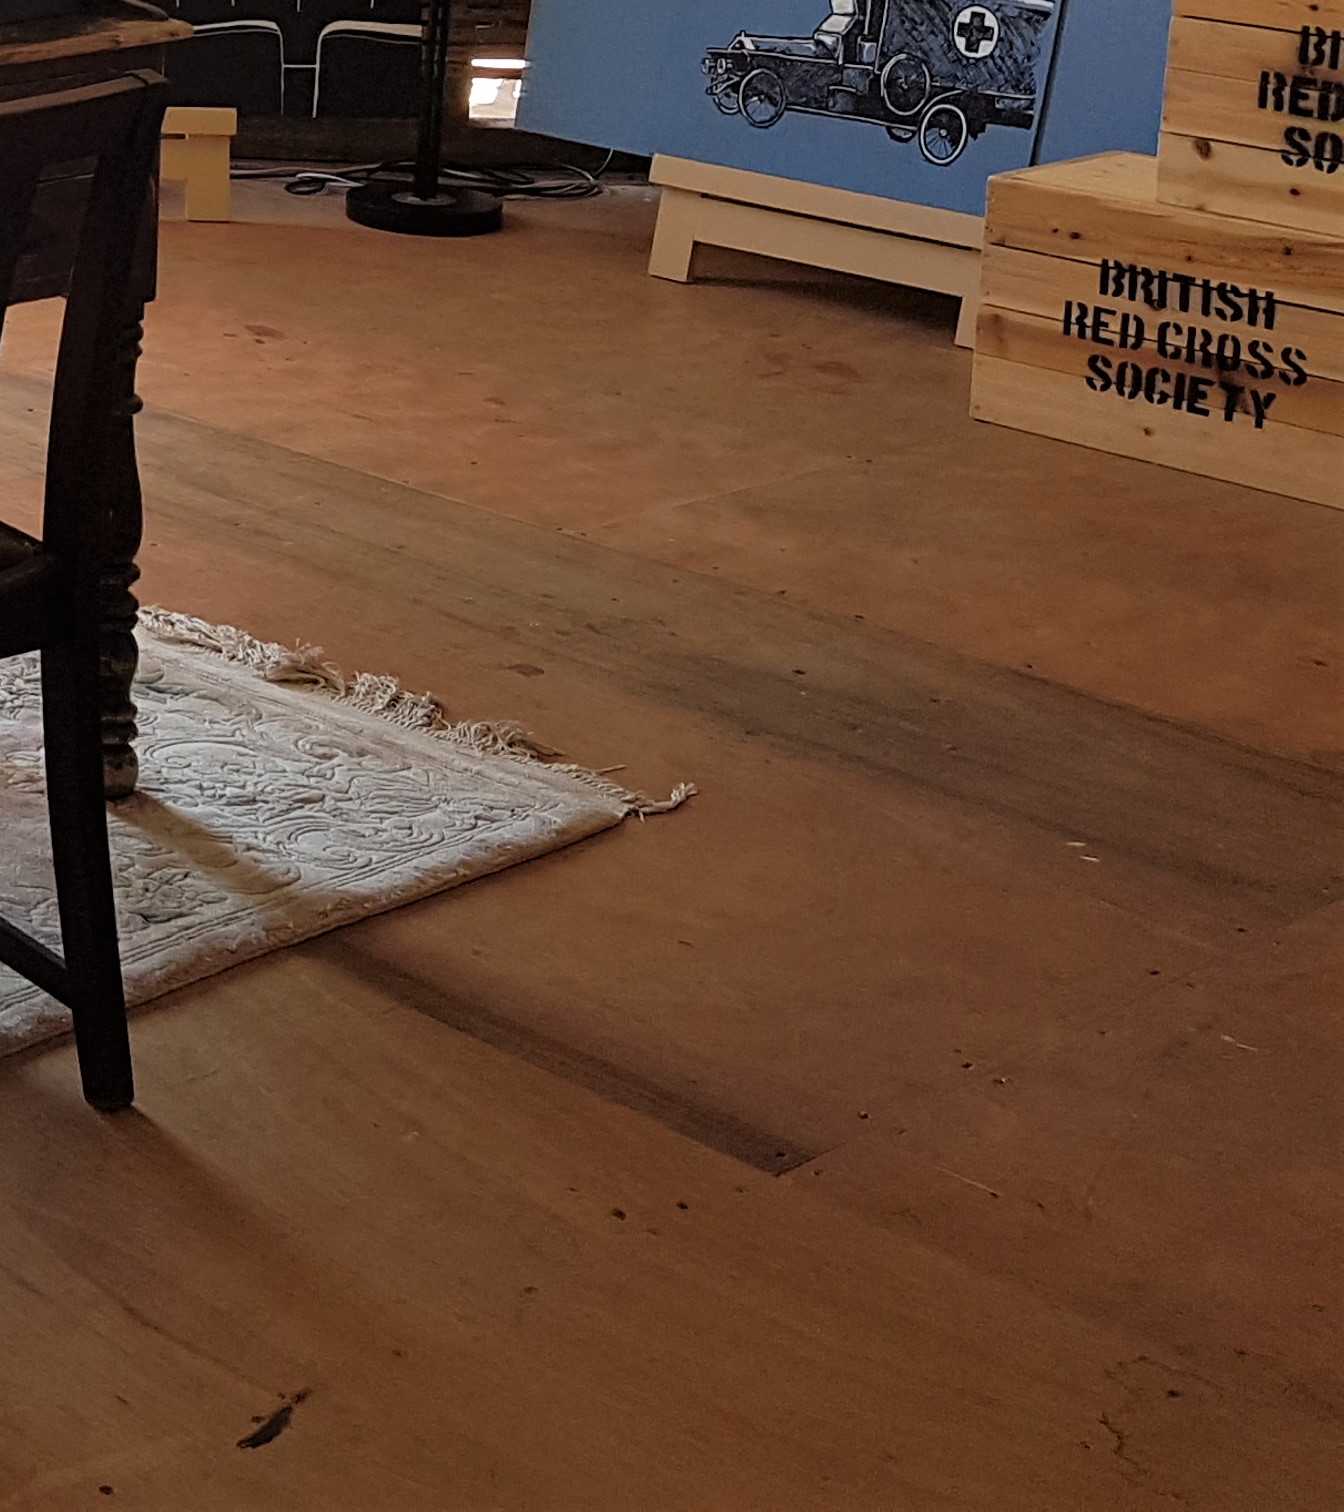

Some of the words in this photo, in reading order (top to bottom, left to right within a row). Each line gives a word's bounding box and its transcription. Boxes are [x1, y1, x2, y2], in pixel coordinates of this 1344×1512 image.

[1098, 257, 1277, 331] BRITISH
[1062, 299, 1146, 351] RED
[1156, 320, 1309, 387] CROSS
[1084, 353, 1278, 430] SOCIETY
